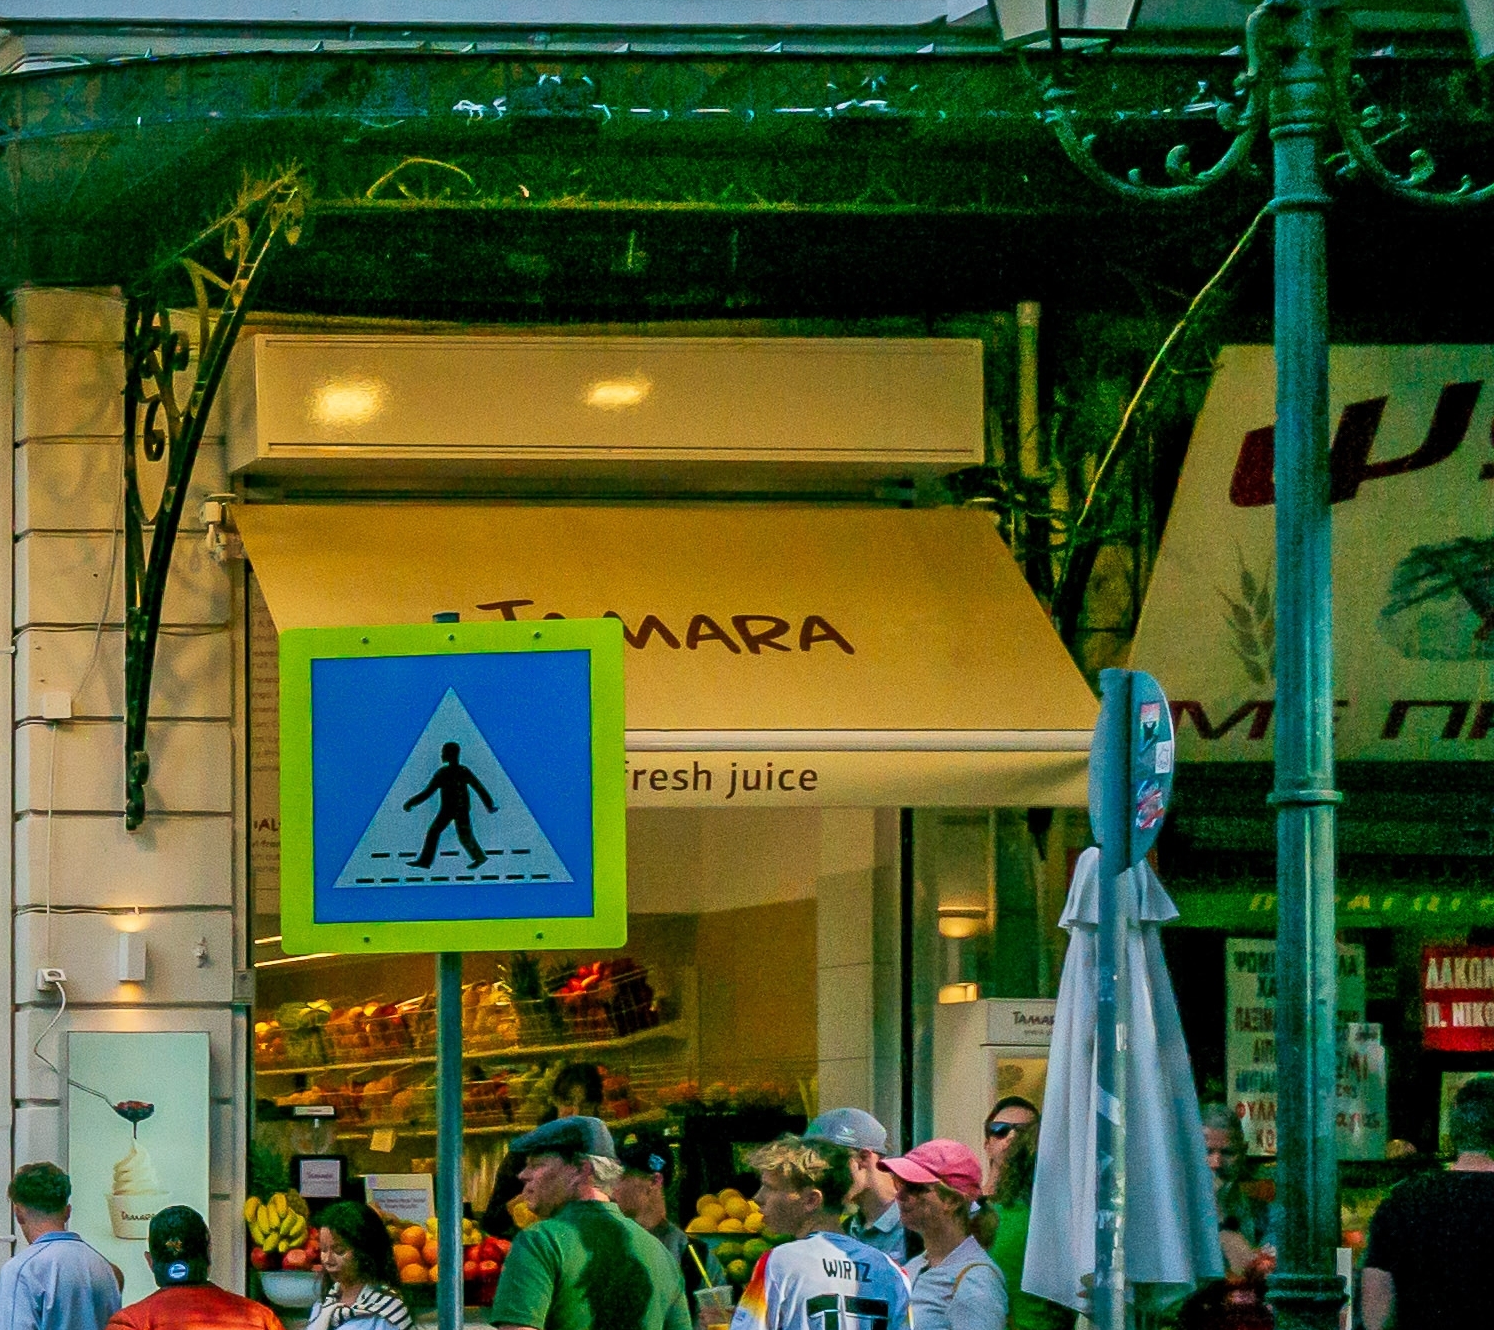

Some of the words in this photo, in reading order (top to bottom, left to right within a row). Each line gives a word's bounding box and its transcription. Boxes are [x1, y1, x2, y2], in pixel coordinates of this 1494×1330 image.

[476, 599, 855, 655] TMARA
[624, 761, 713, 791] resh
[726, 761, 818, 799] juice
[1013, 1011, 1055, 1025] TAMAR
[822, 1257, 873, 1283] WIRTZ
